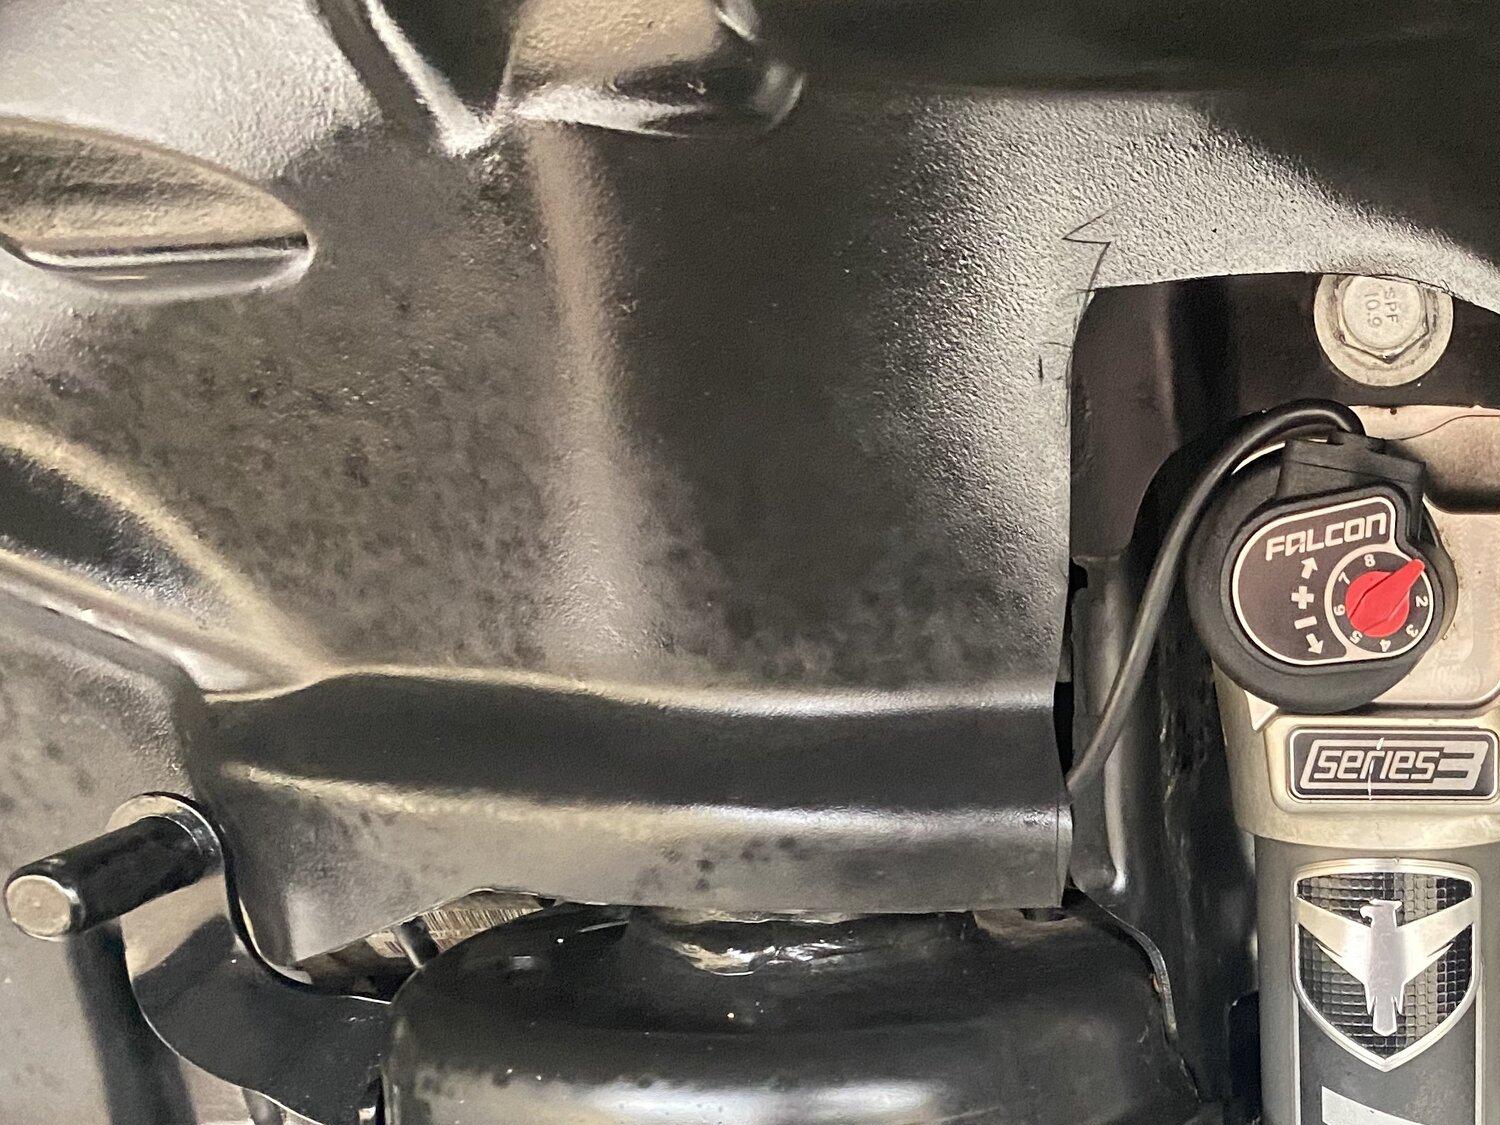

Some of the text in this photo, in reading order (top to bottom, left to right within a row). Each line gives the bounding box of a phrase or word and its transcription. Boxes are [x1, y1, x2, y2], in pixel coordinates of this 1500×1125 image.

[1384, 289, 1399, 324] SPF
[1265, 512, 1387, 562] FALCON
[1363, 553, 1376, 568] 8
[1338, 571, 1351, 585] 7
[1415, 595, 1429, 608] 2
[1333, 603, 1346, 616] 6
[1349, 630, 1363, 645] 5
[1405, 624, 1419, 638] 3
[1379, 639, 1392, 653] 4
